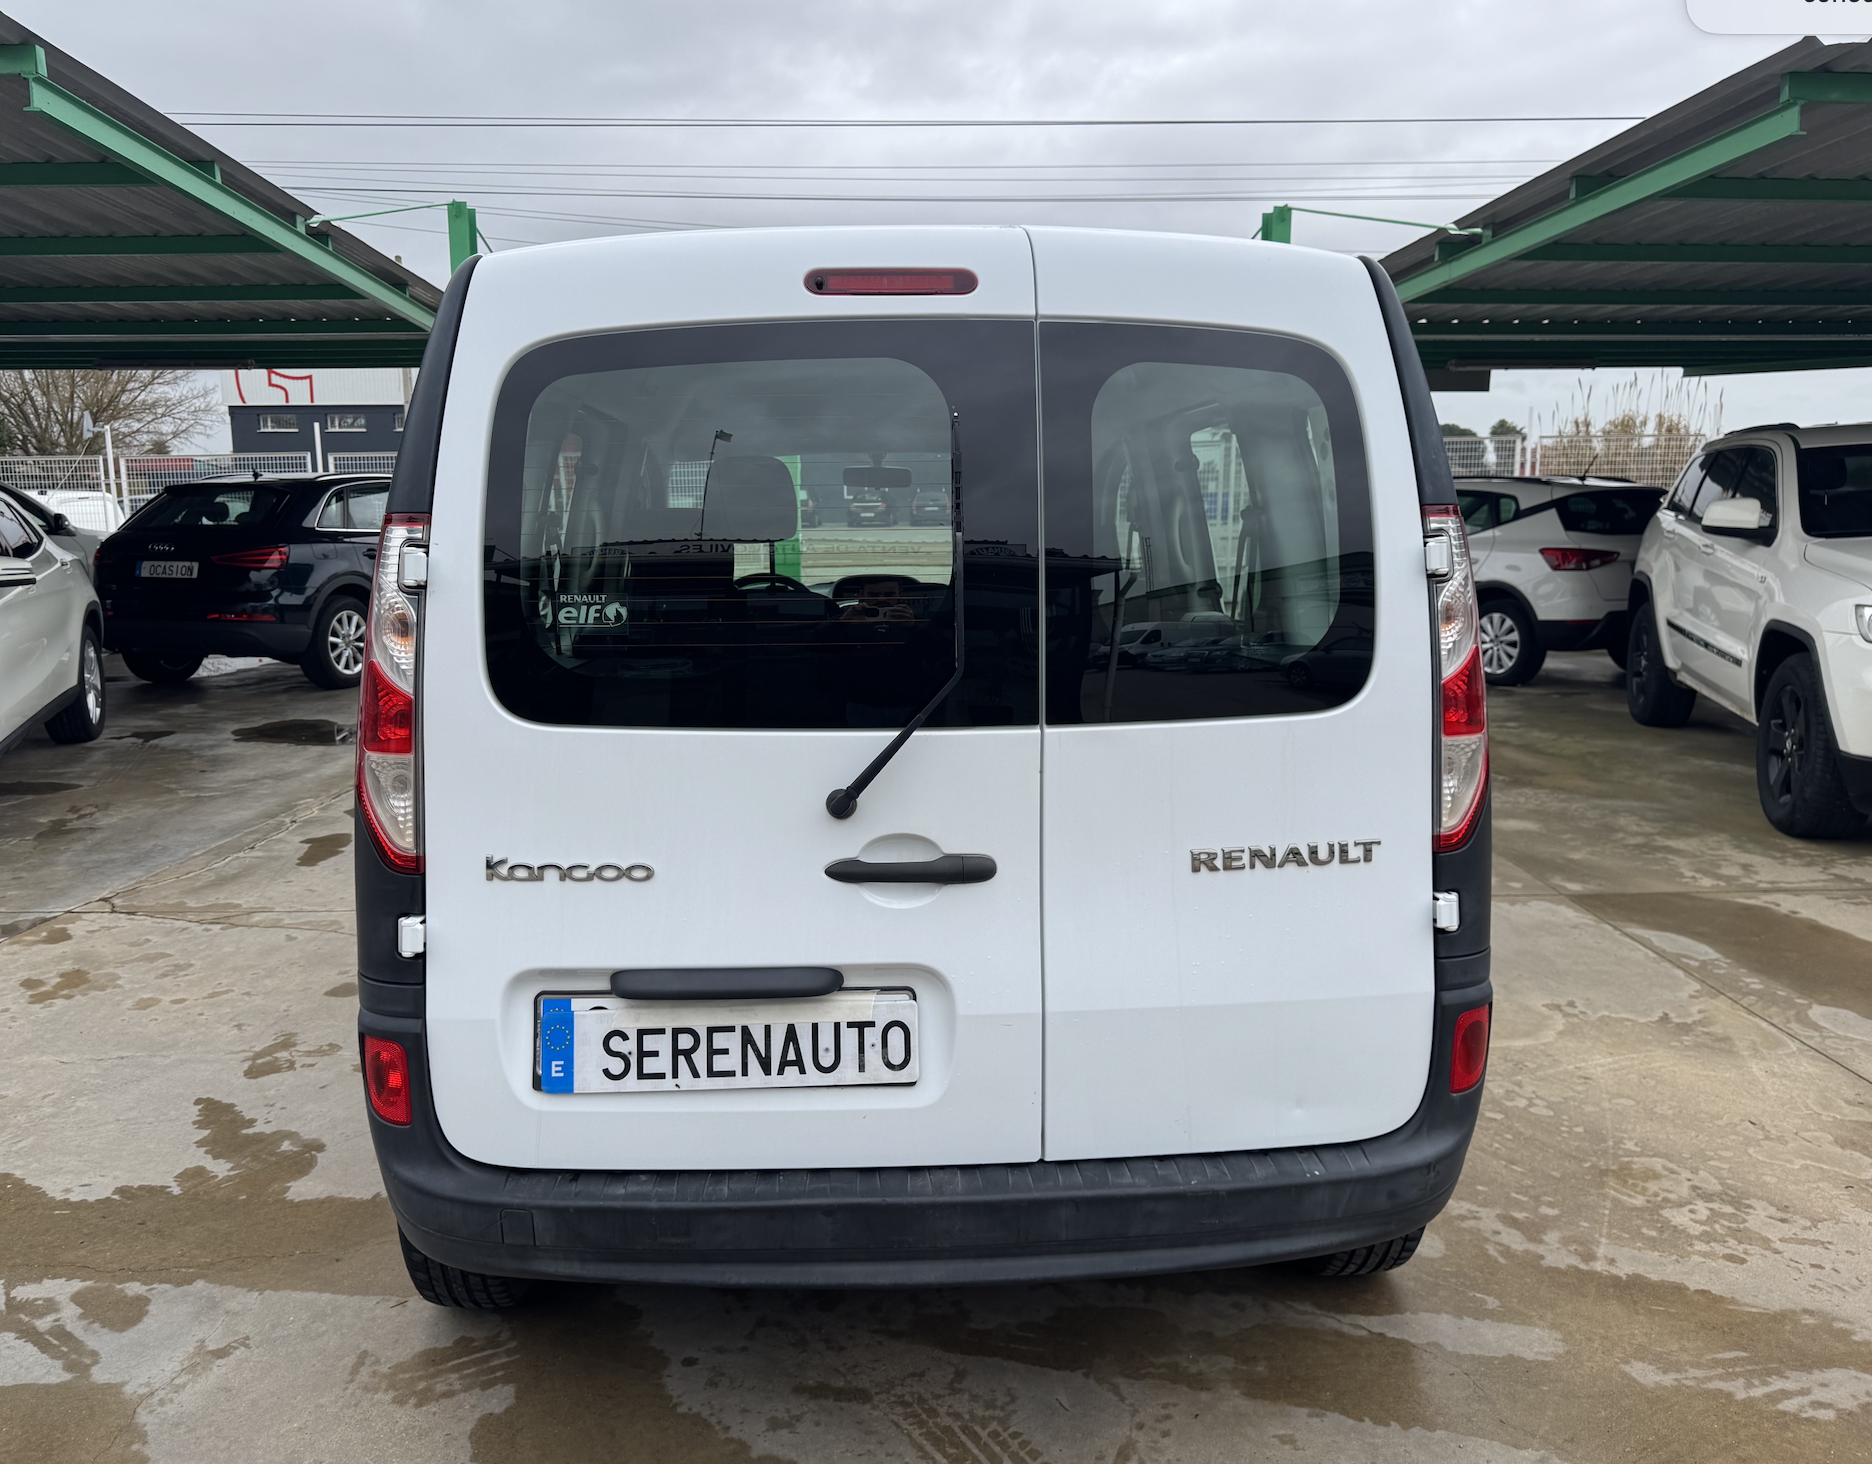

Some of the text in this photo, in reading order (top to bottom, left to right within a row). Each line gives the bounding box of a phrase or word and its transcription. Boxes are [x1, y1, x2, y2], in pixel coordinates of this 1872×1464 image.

[149, 564, 194, 577] OCASION
[559, 594, 608, 604] RENAULT
[557, 604, 602, 624] elf
[1190, 838, 1381, 872] RENAULT
[602, 1020, 911, 1081] SERENAUTO
[551, 1061, 564, 1077] E
